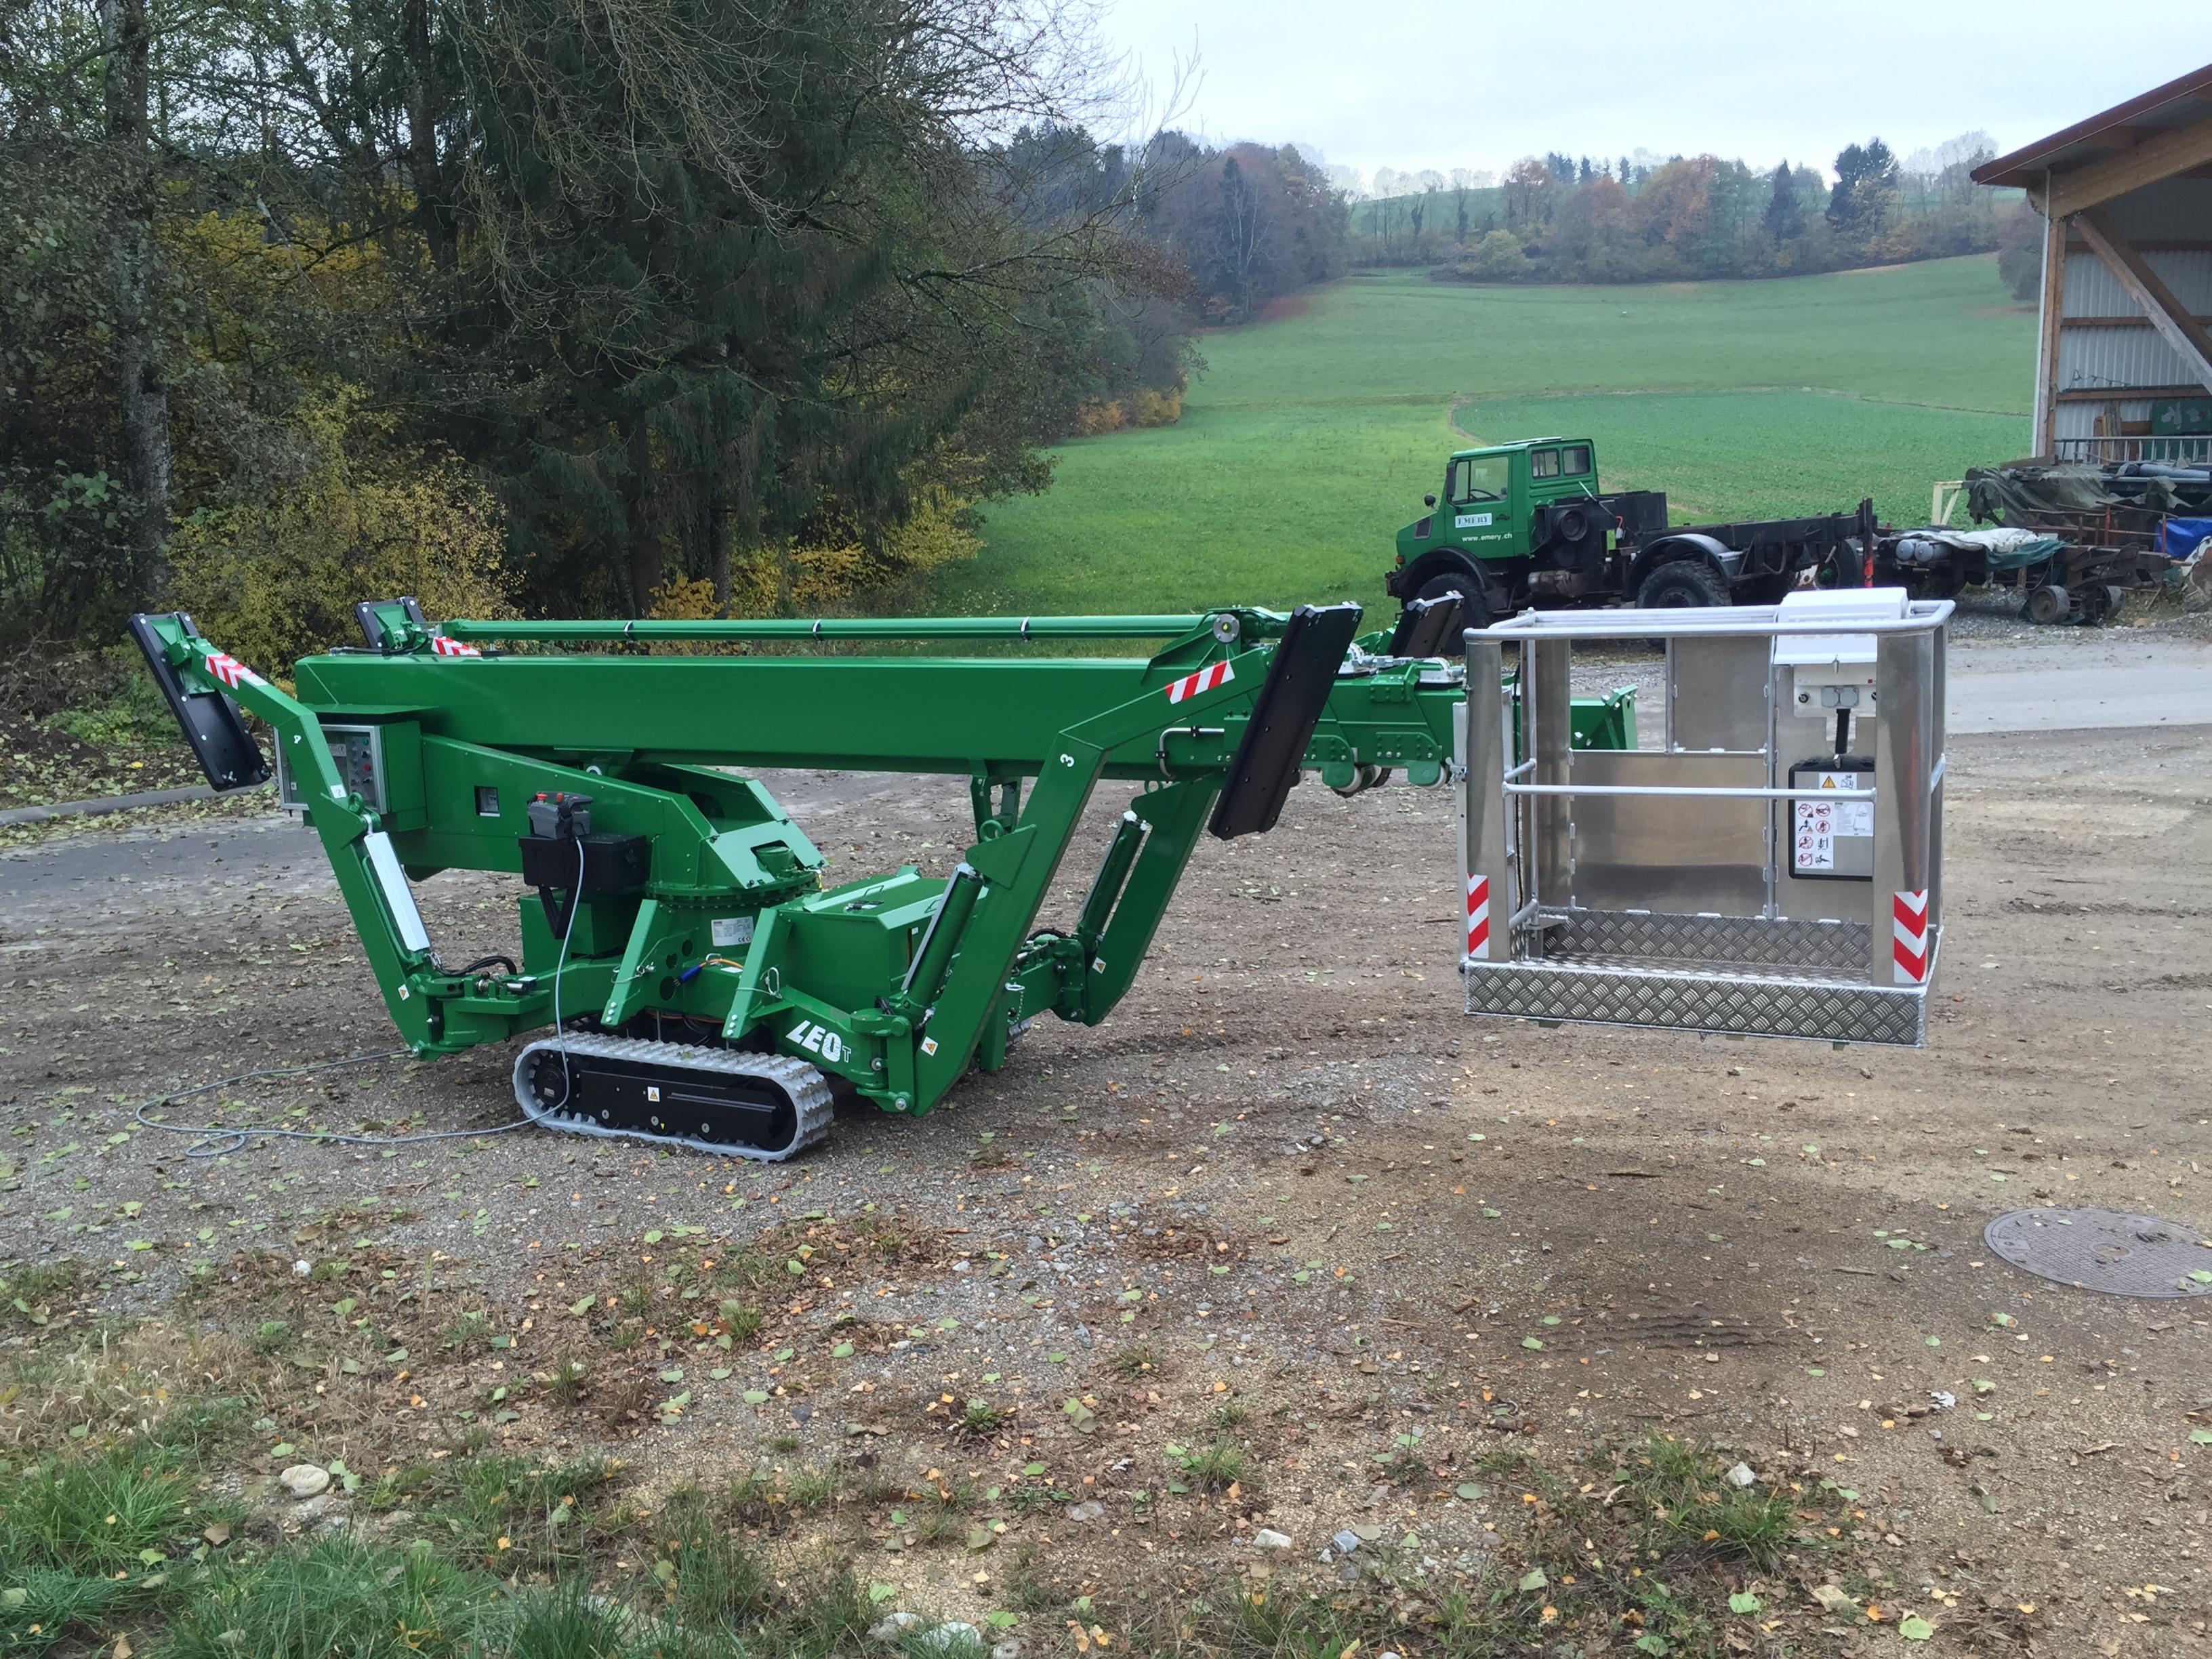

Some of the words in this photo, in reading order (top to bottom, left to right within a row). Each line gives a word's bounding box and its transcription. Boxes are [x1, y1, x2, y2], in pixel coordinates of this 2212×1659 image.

[1458, 516, 1488, 525] EMERY
[1462, 532, 1513, 541] www.emery.ch
[1060, 753, 1075, 767] 3
[785, 1019, 842, 1063] LEO
